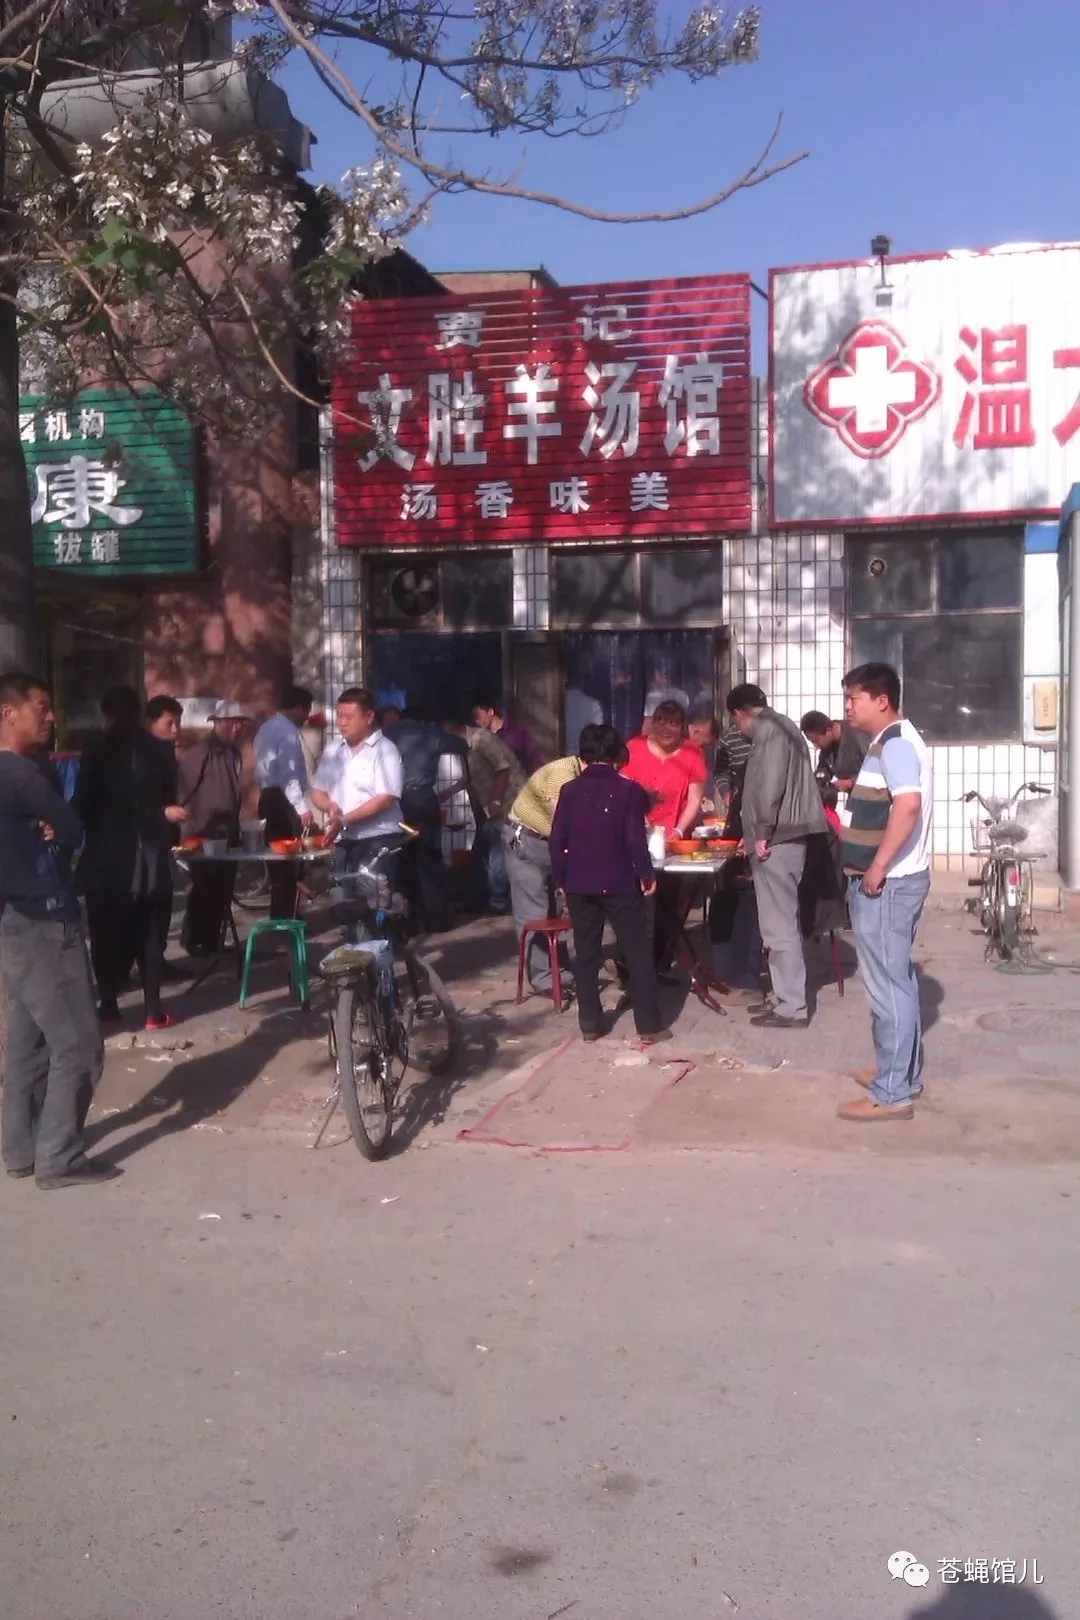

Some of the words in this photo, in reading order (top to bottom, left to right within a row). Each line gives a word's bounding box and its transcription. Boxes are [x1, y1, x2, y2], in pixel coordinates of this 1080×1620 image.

[434, 305, 633, 351] 贾记
[357, 352, 723, 473] 文胜羊汤馆
[31, 455, 143, 528] 康
[400, 471, 670, 521] 汤香味美
[54, 530, 120, 564] 拔罐
